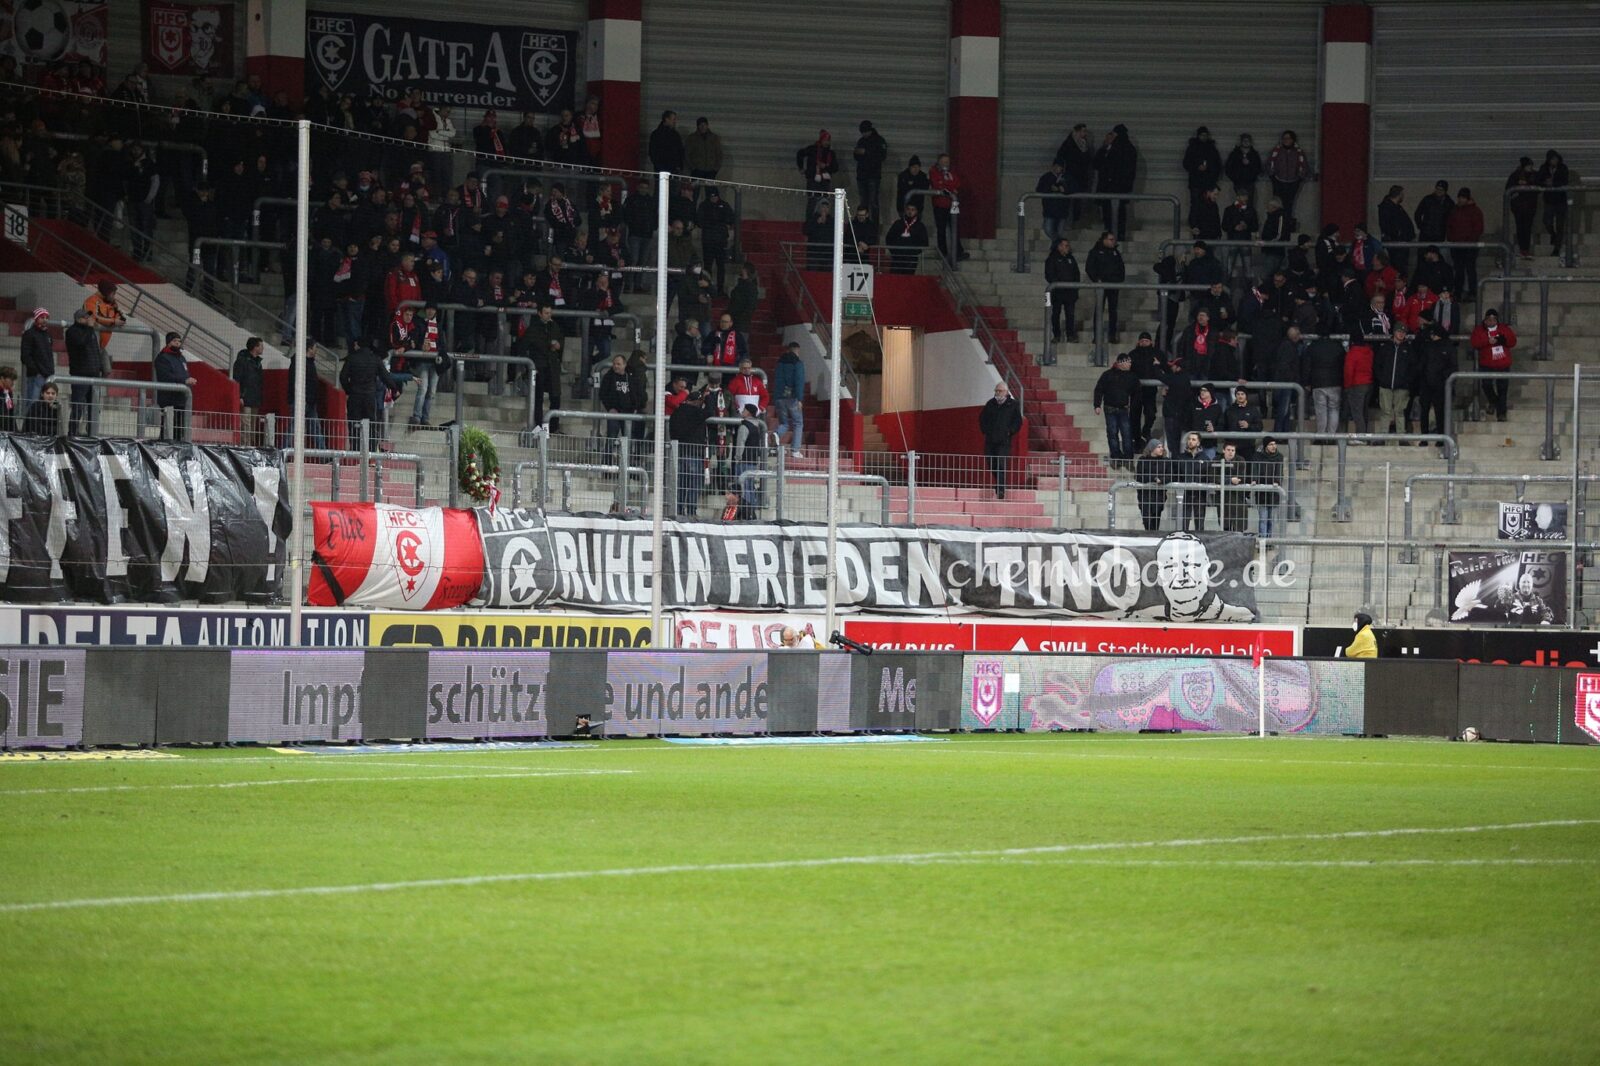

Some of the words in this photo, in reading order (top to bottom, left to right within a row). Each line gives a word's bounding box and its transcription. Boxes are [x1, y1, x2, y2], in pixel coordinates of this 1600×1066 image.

[154, 12, 187, 26] HFC
[315, 19, 346, 33] HFC
[528, 34, 558, 49] HFC
[363, 22, 474, 84] GATE
[478, 31, 517, 93] A
[368, 83, 399, 100] No
[9, 213, 25, 237] 18
[847, 271, 869, 292] 17
[1504, 505, 1521, 513] HFC
[389, 511, 418, 527] HFC
[1523, 553, 1560, 564] HFC
[554, 530, 654, 603] RUHE
[670, 536, 712, 604] IN
[984, 546, 1142, 611] TINO
[198, 617, 365, 646] AUTOMTION
[1039, 641, 1087, 652] SWH
[1221, 644, 1272, 657] Hale
[976, 663, 1000, 675] HFC
[428, 664, 550, 723] schütz
[625, 666, 685, 721] und
